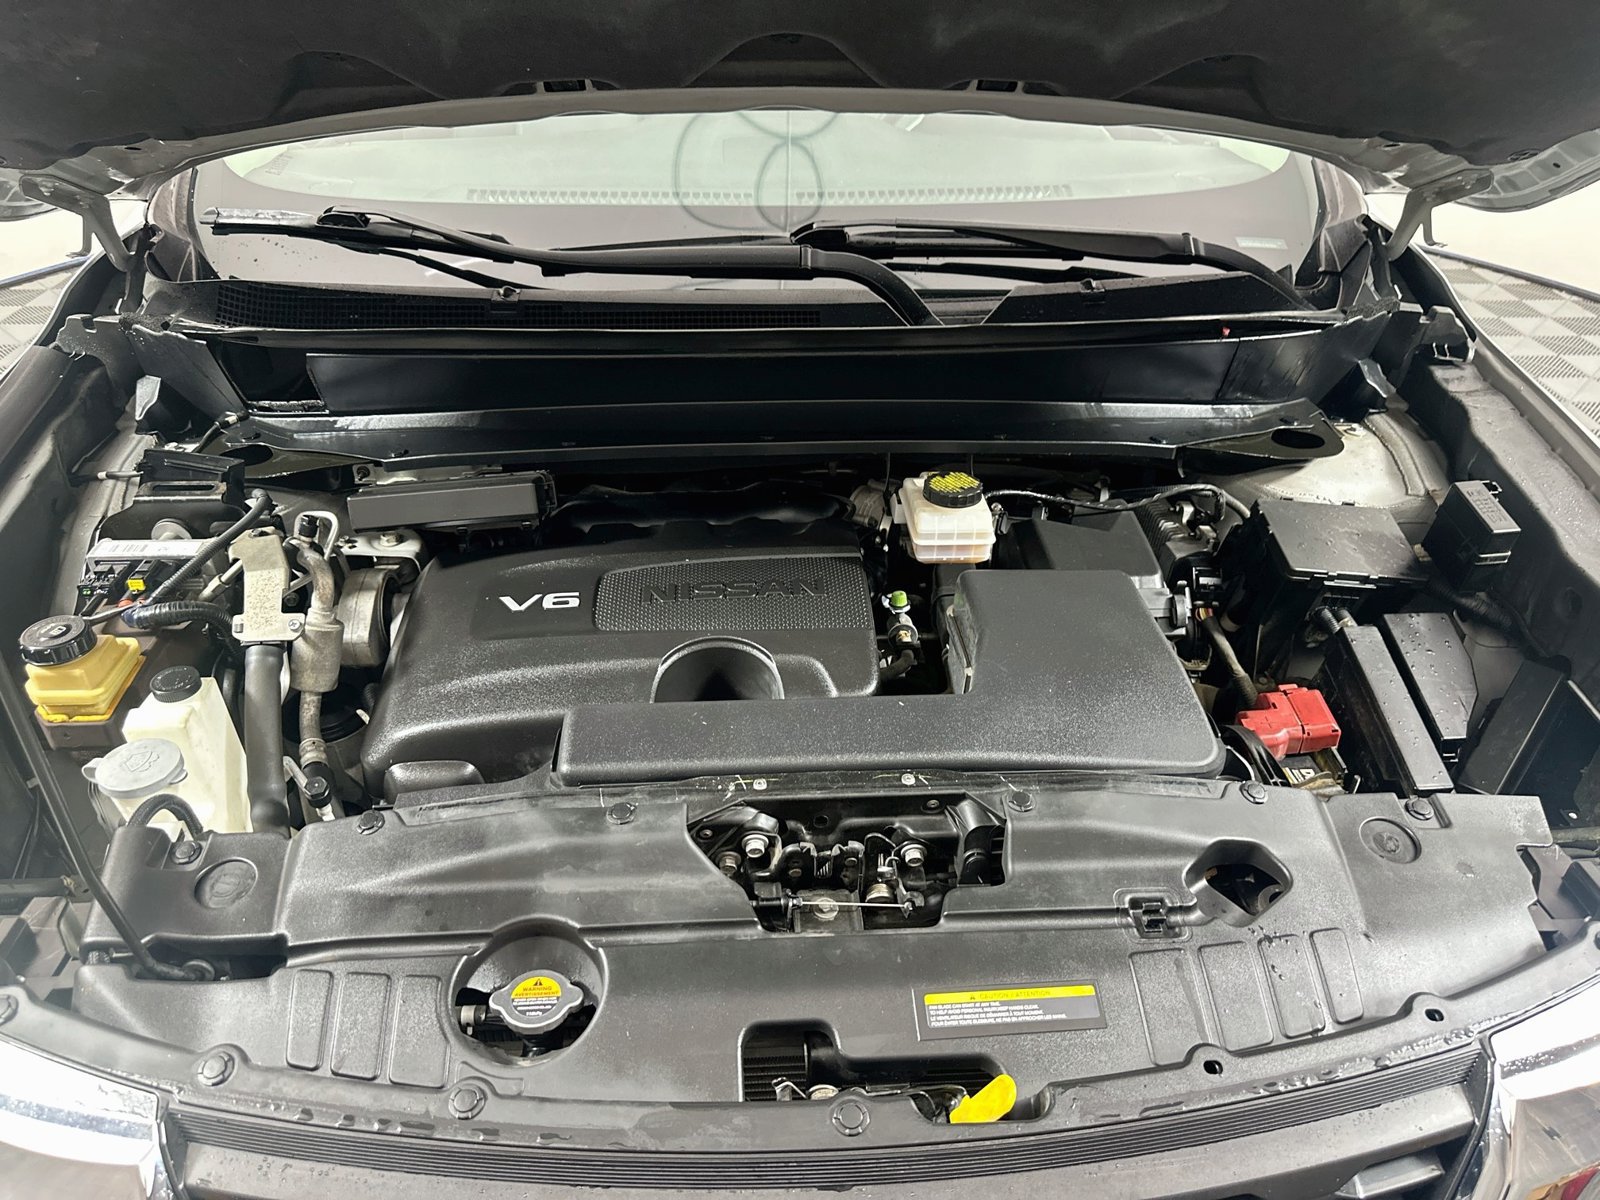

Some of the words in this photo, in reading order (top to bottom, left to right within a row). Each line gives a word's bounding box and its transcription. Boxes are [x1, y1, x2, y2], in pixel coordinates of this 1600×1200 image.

[641, 575, 827, 603] NISSAN
[499, 591, 580, 612] V6
[1015, 990, 1051, 998] ATTENTION
